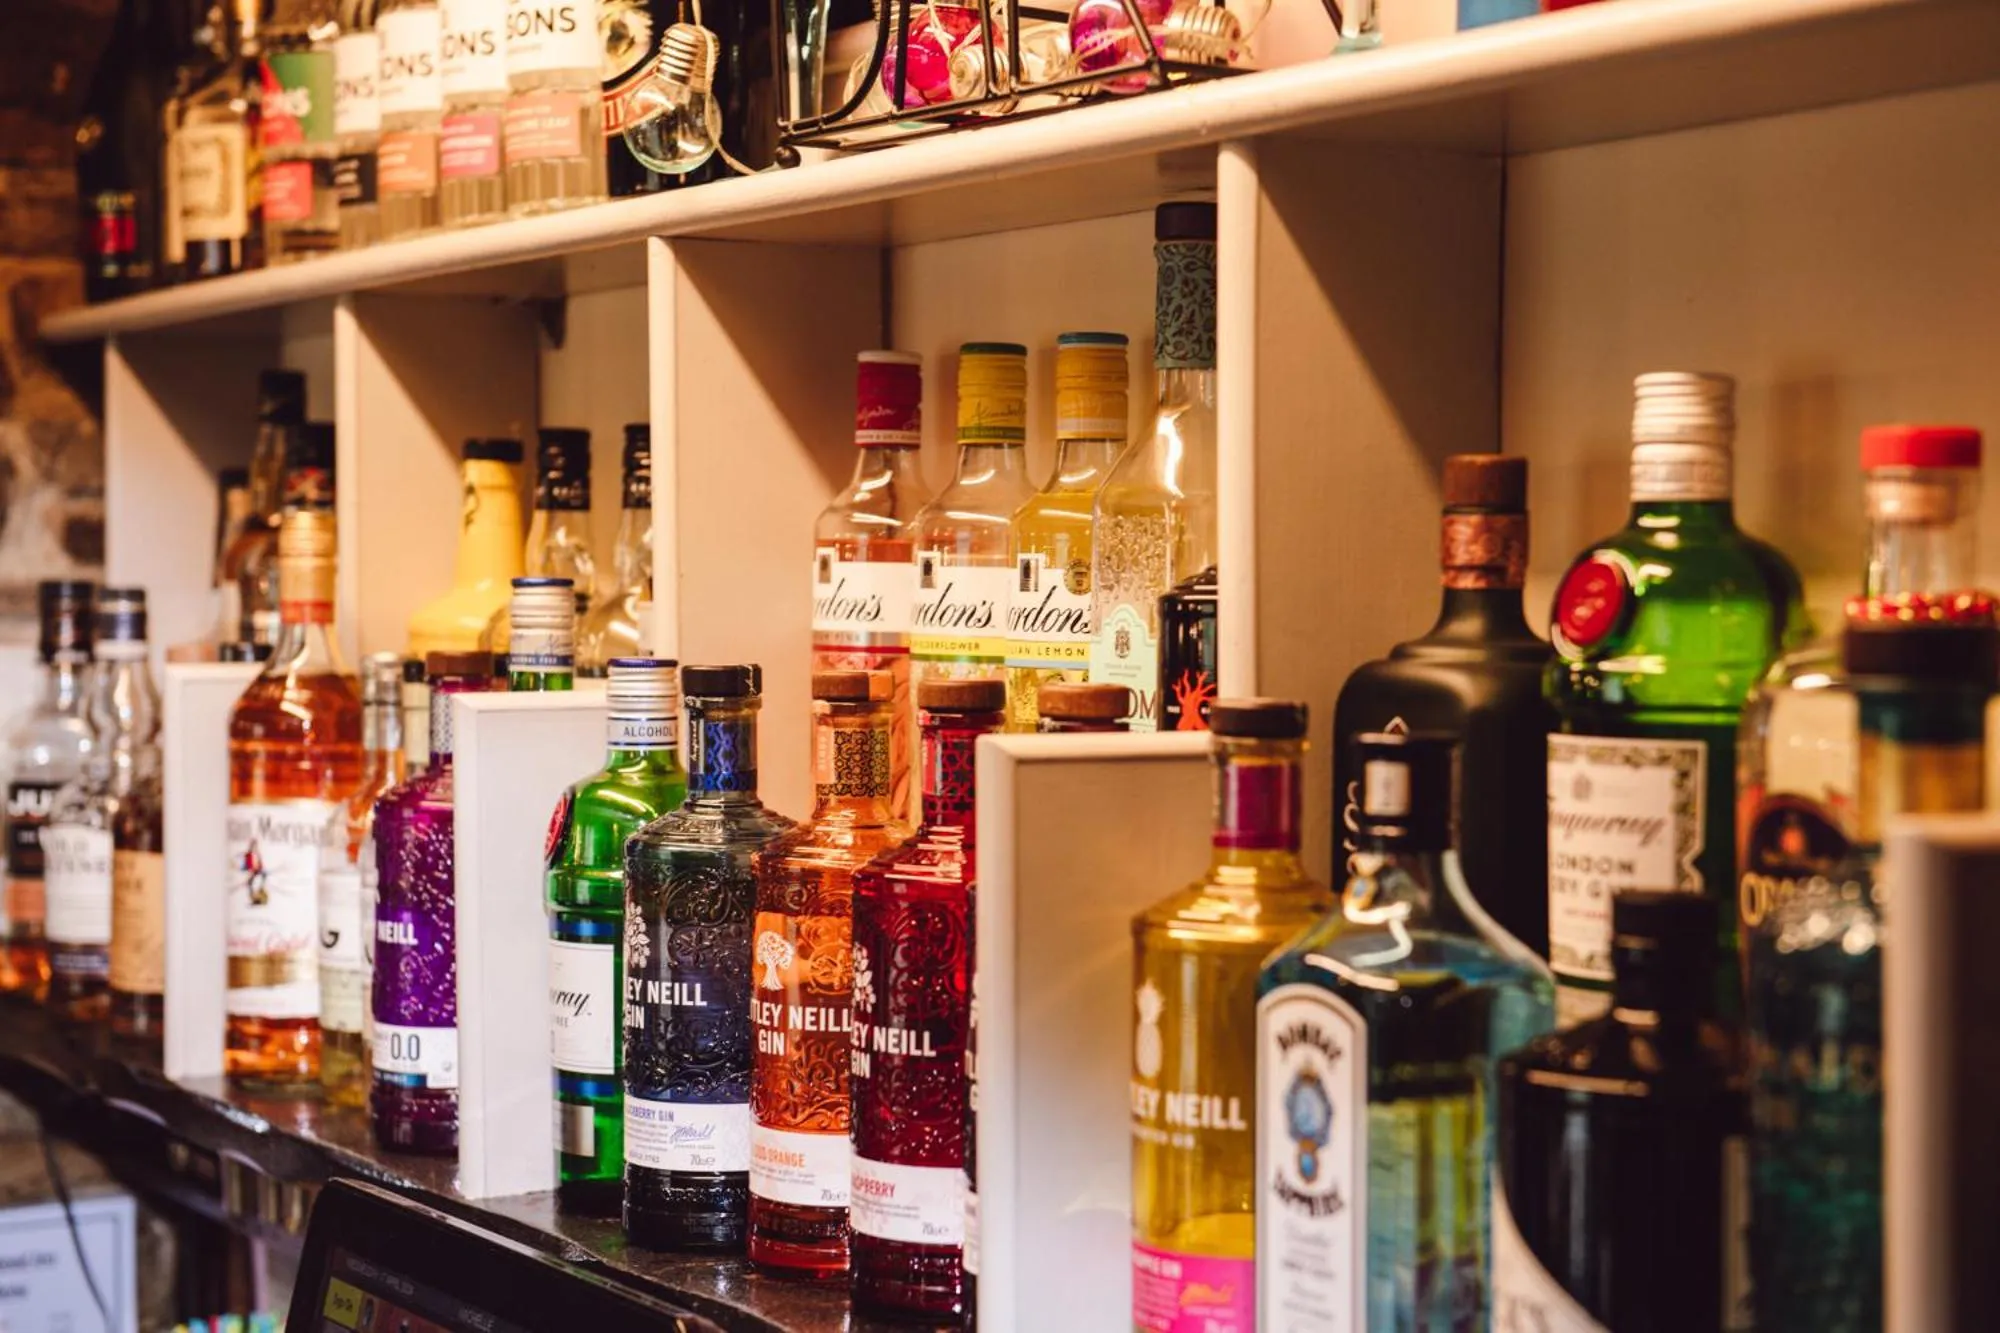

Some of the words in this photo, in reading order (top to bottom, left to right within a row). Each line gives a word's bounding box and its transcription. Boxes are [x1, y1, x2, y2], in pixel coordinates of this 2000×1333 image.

[1037, 647, 1086, 658] LEMON
[623, 727, 673, 739] ALCOHOL
[647, 980, 707, 1006] NEILL
[788, 1005, 851, 1032] NEILL
[391, 1032, 420, 1061] 0.0
[758, 1028, 785, 1057] GIN
[872, 1026, 937, 1058] NEILL
[658, 1110, 674, 1123] GIN
[1165, 1091, 1248, 1131] NEILL
